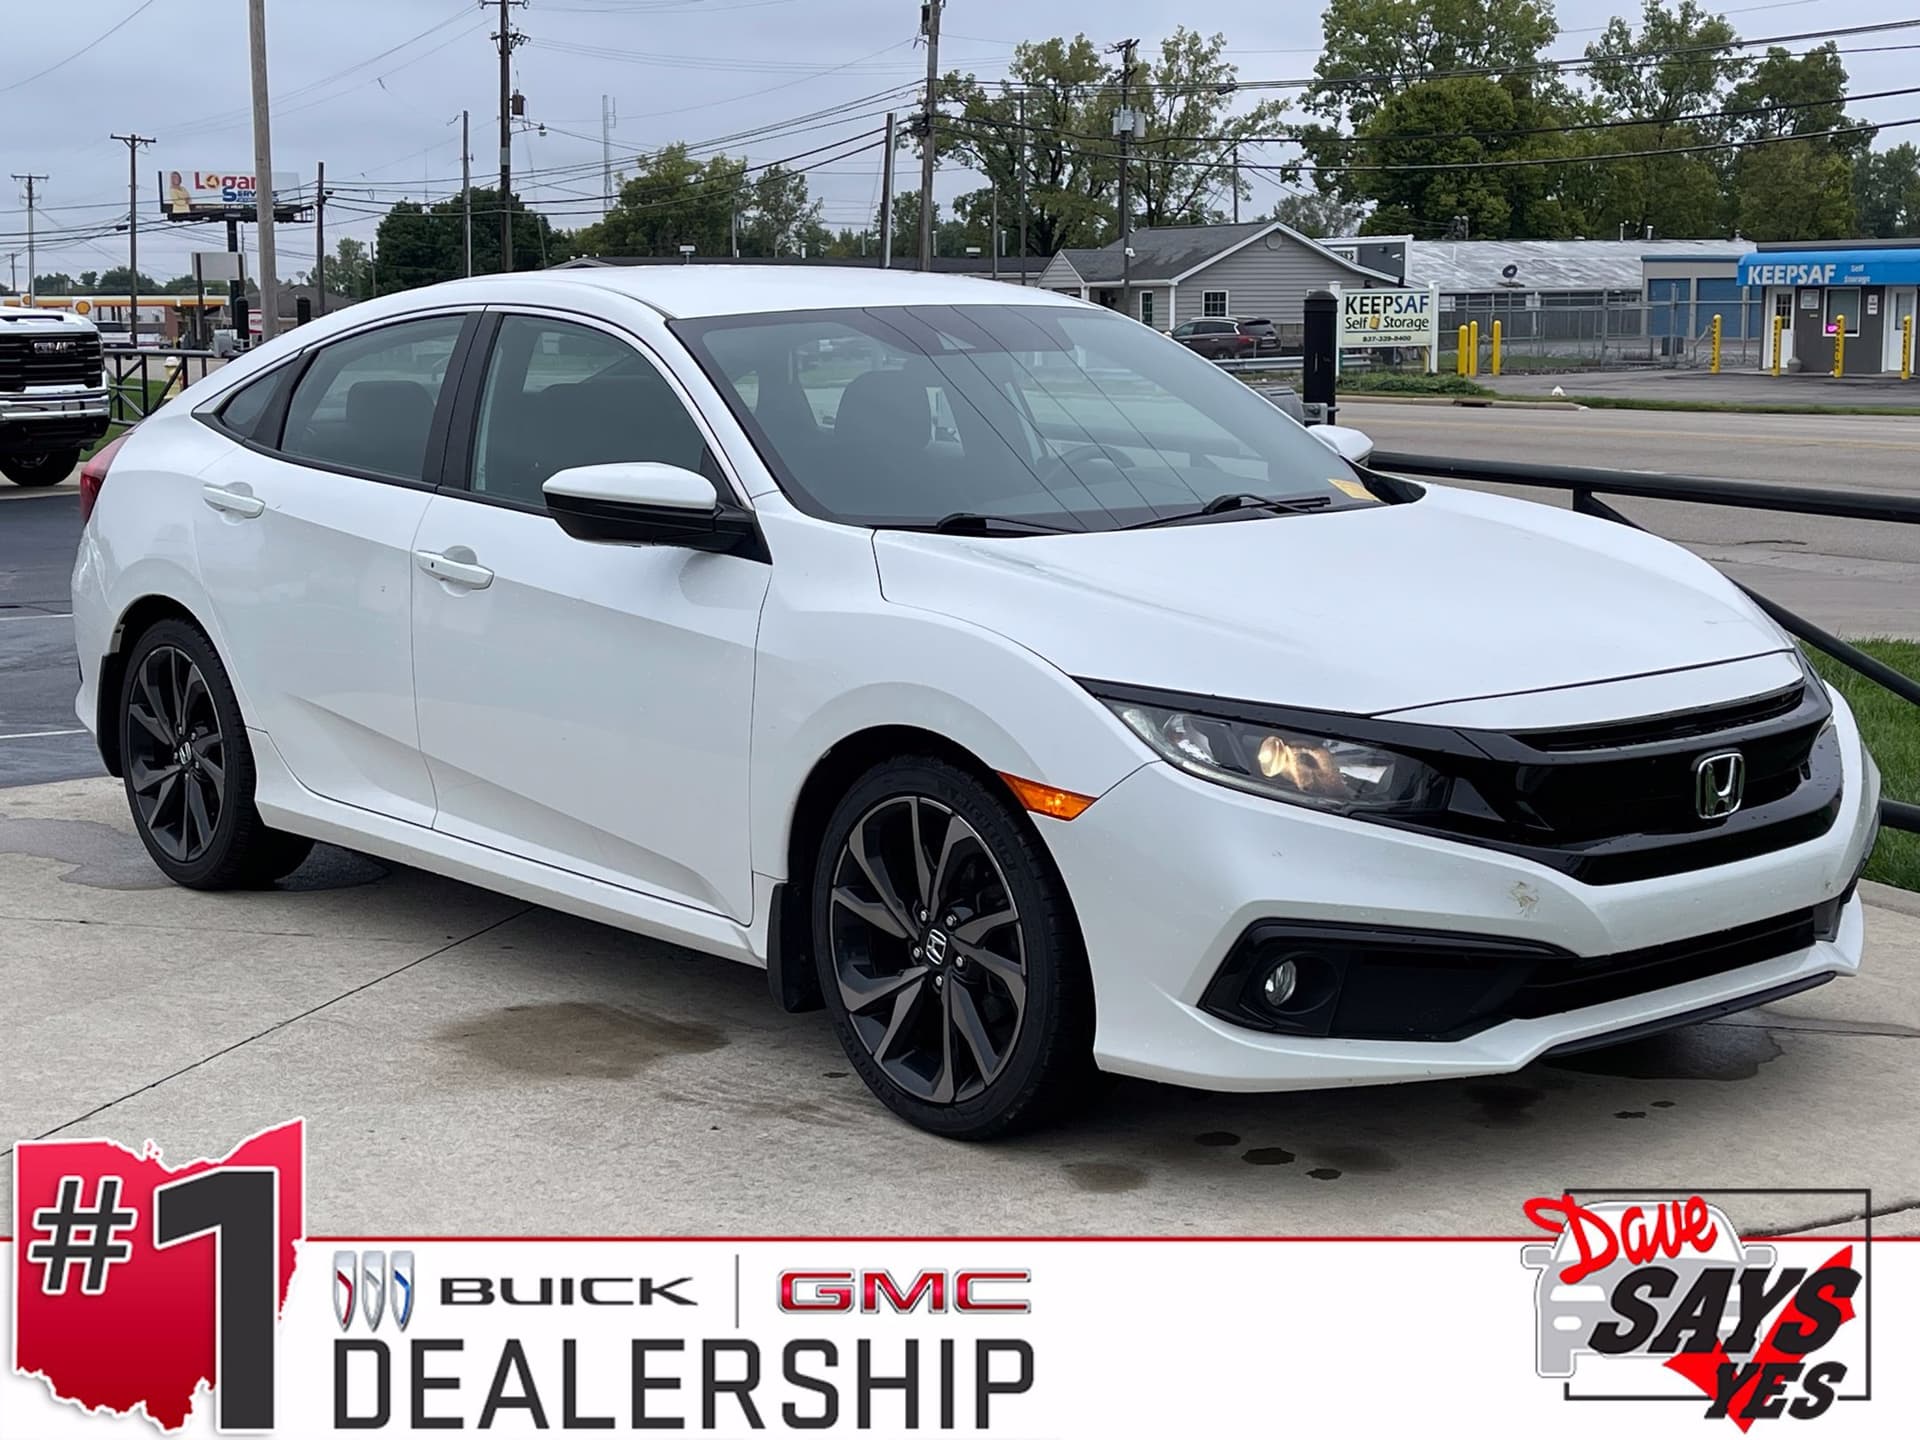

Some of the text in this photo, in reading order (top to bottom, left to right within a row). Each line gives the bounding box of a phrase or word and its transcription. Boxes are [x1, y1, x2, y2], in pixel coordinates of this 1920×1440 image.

[1747, 263, 1837, 285] KEEPSAF
[1345, 295, 1430, 315] KEEPSAF
[1345, 315, 1429, 332] Self Storage
